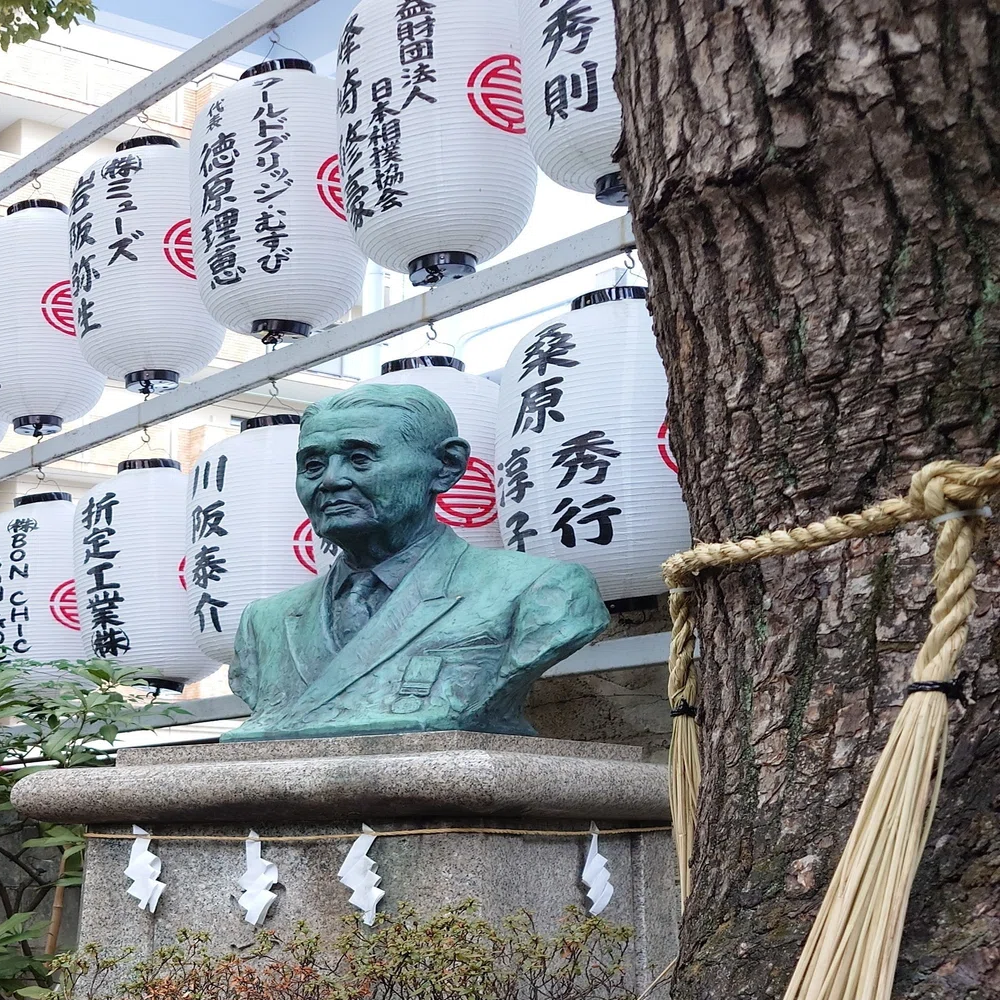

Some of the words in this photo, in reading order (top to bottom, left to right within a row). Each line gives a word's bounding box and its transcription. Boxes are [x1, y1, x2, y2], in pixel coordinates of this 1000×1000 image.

[206, 98, 225, 135] 代表
[367, 77, 408, 212] 日本相撲協会
[191, 454, 229, 632] 川阪泰介
[550, 430, 622, 548] 秀行
